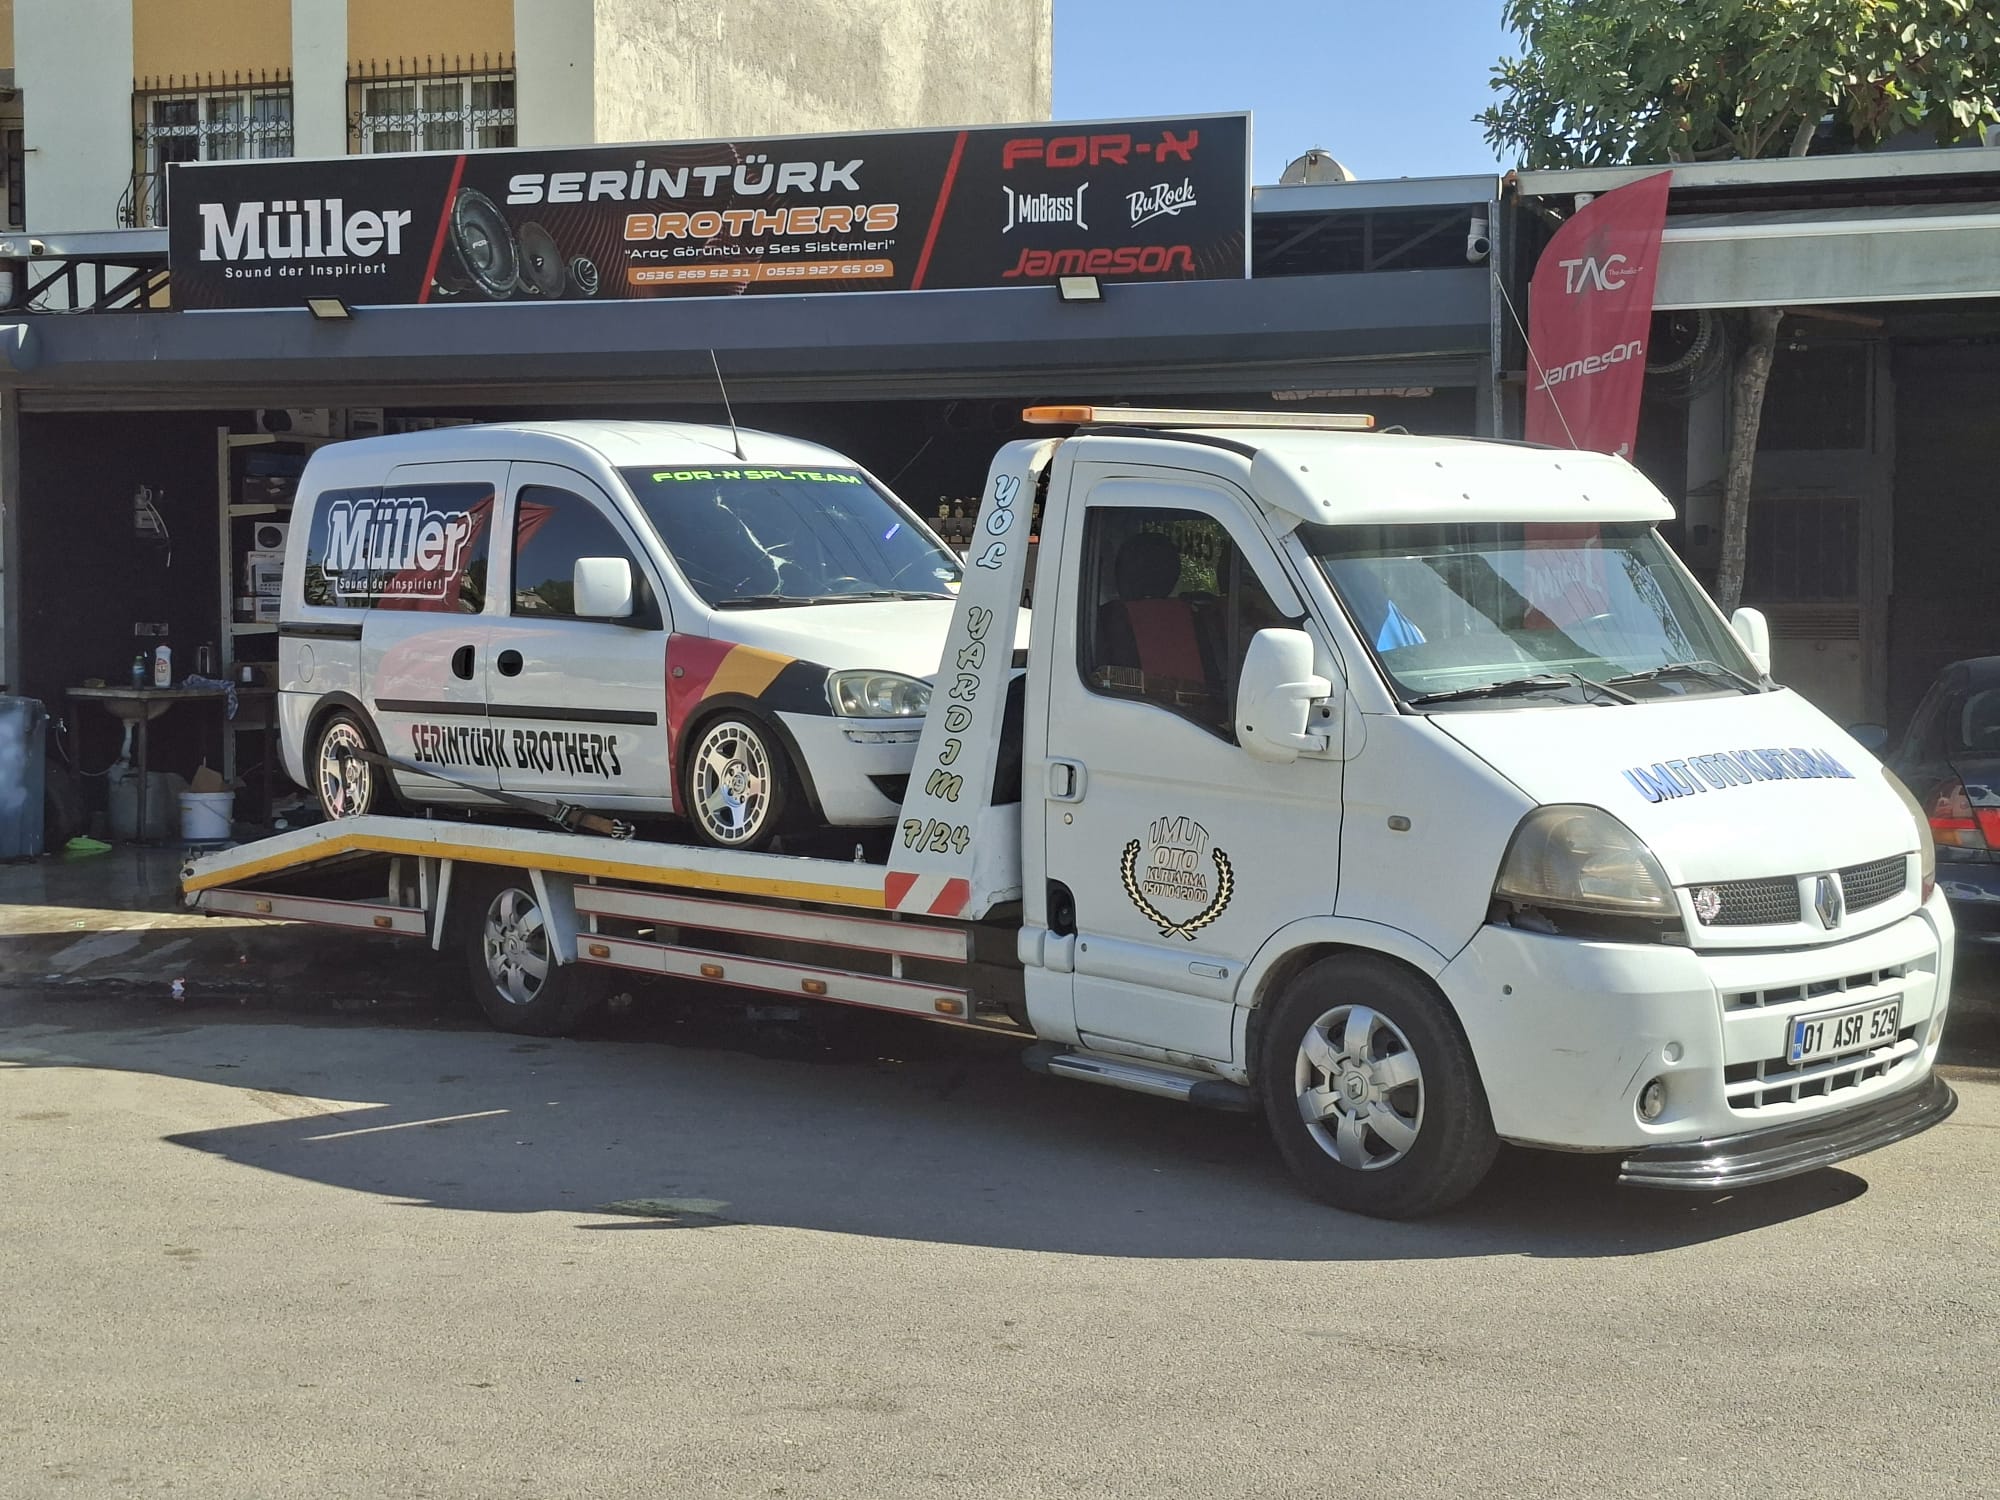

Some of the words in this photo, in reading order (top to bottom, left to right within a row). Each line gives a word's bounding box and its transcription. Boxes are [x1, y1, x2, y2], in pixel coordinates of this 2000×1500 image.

[506, 154, 864, 205] SERİNTÜRK
[1125, 177, 1196, 227] BuRock
[199, 198, 412, 261] Müller
[624, 204, 900, 241] BROTHER'S
[673, 244, 741, 257] Görüntü
[745, 246, 764, 255] ve
[768, 244, 801, 254] Ses
[225, 266, 272, 279] Sound
[279, 265, 304, 277] der
[311, 263, 387, 278] Inspiriert
[636, 271, 675, 281] 0536
[677, 269, 707, 280] 269
[709, 269, 729, 279] 52
[731, 268, 751, 278] 31
[808, 265, 838, 275] 927
[841, 264, 862, 274] 65
[864, 263, 885, 273] 09
[1558, 254, 1627, 294] TAC
[326, 507, 467, 571] Müller
[339, 578, 368, 589] Sound
[372, 578, 388, 589] der
[391, 577, 442, 592] Inspiriert
[512, 729, 622, 780] BROTHER'S
[1687, 752, 1753, 789] OTO
[903, 818, 970, 855] 7/24
[1148, 816, 1210, 855] UMUT
[1146, 865, 1207, 889] KURTARMA
[1153, 846, 1199, 873] OTO
[1802, 1022, 1824, 1054] 01
[1832, 1015, 1864, 1048] ASR
[1870, 1006, 1897, 1039] 529
